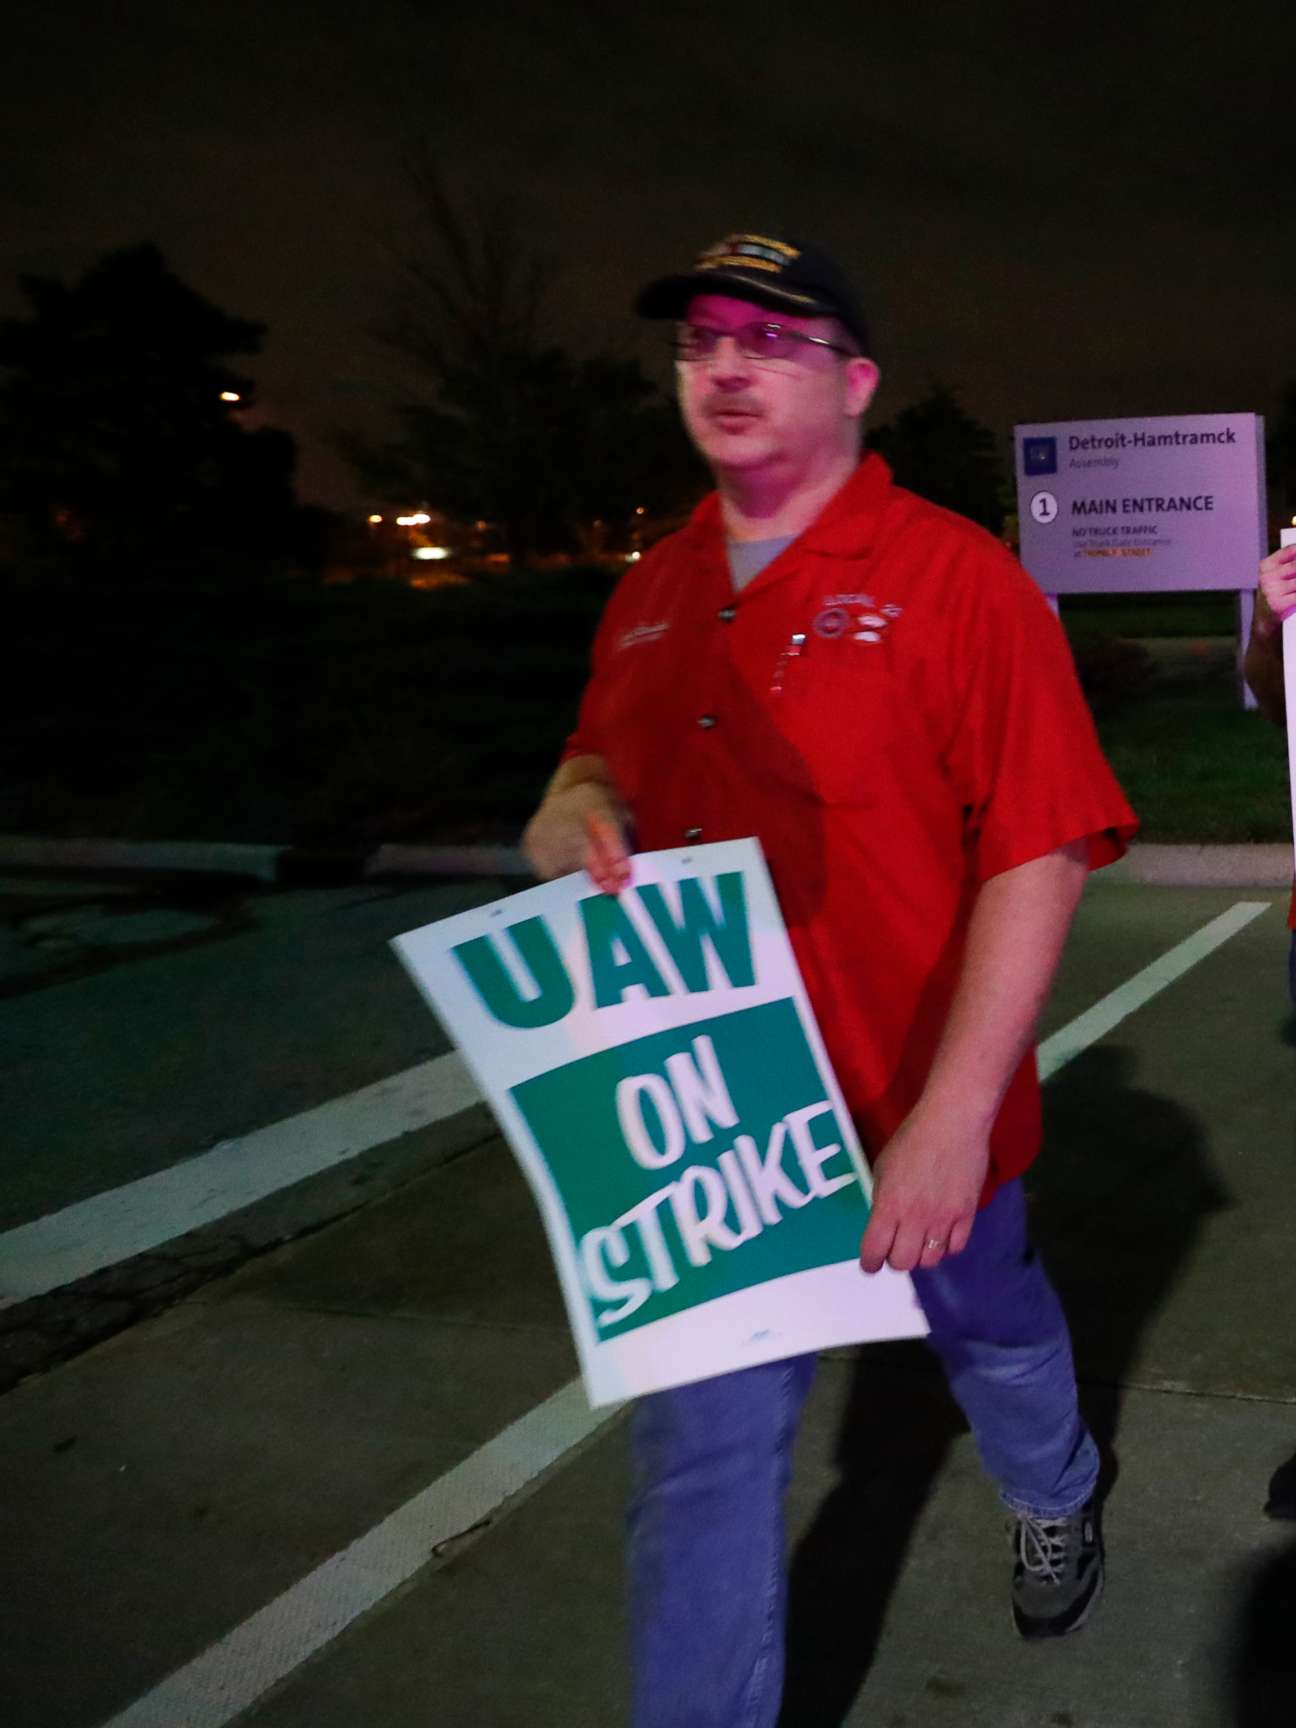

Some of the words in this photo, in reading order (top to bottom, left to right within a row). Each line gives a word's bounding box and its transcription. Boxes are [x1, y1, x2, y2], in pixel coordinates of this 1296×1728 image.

[1068, 428, 1236, 451] Detroit-Hamtramck
[1038, 498, 1051, 517] 1
[1071, 499, 1117, 516] MAIN
[1122, 495, 1214, 514] ENTRANCE
[1072, 527, 1087, 537] NO
[1088, 526, 1119, 537] TRUCK
[1120, 524, 1159, 535] TRAFFIC
[450, 870, 758, 1031] UAW
[615, 1034, 741, 1171] ON
[578, 1099, 862, 1326] STRIKE
